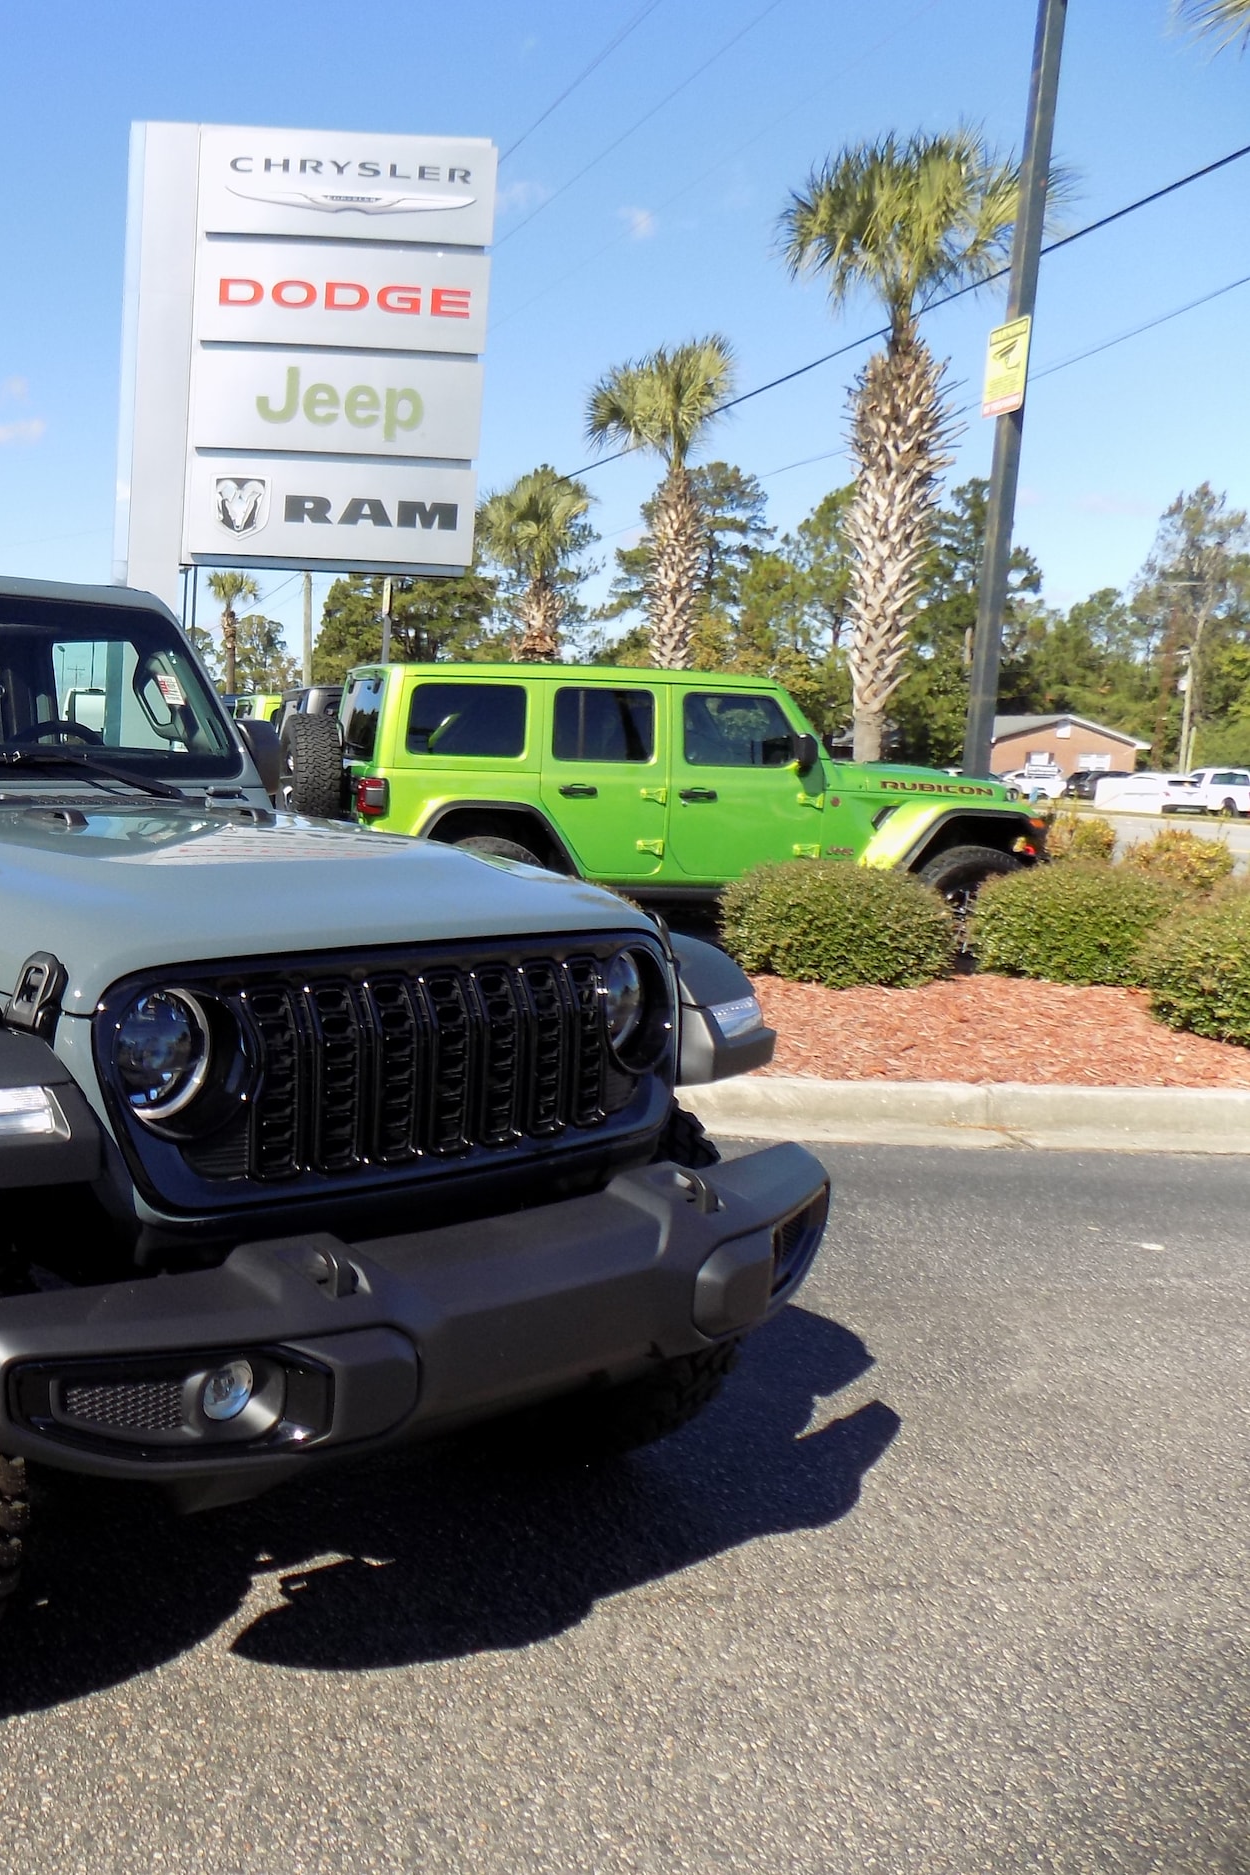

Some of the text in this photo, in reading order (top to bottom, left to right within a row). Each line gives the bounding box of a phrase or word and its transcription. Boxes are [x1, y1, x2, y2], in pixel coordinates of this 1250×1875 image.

[229, 156, 472, 185] CHRYSLER
[218, 278, 471, 319] DODGE
[255, 366, 424, 442] Jeep
[283, 494, 458, 532] RAM
[880, 780, 994, 797] RUBICON
